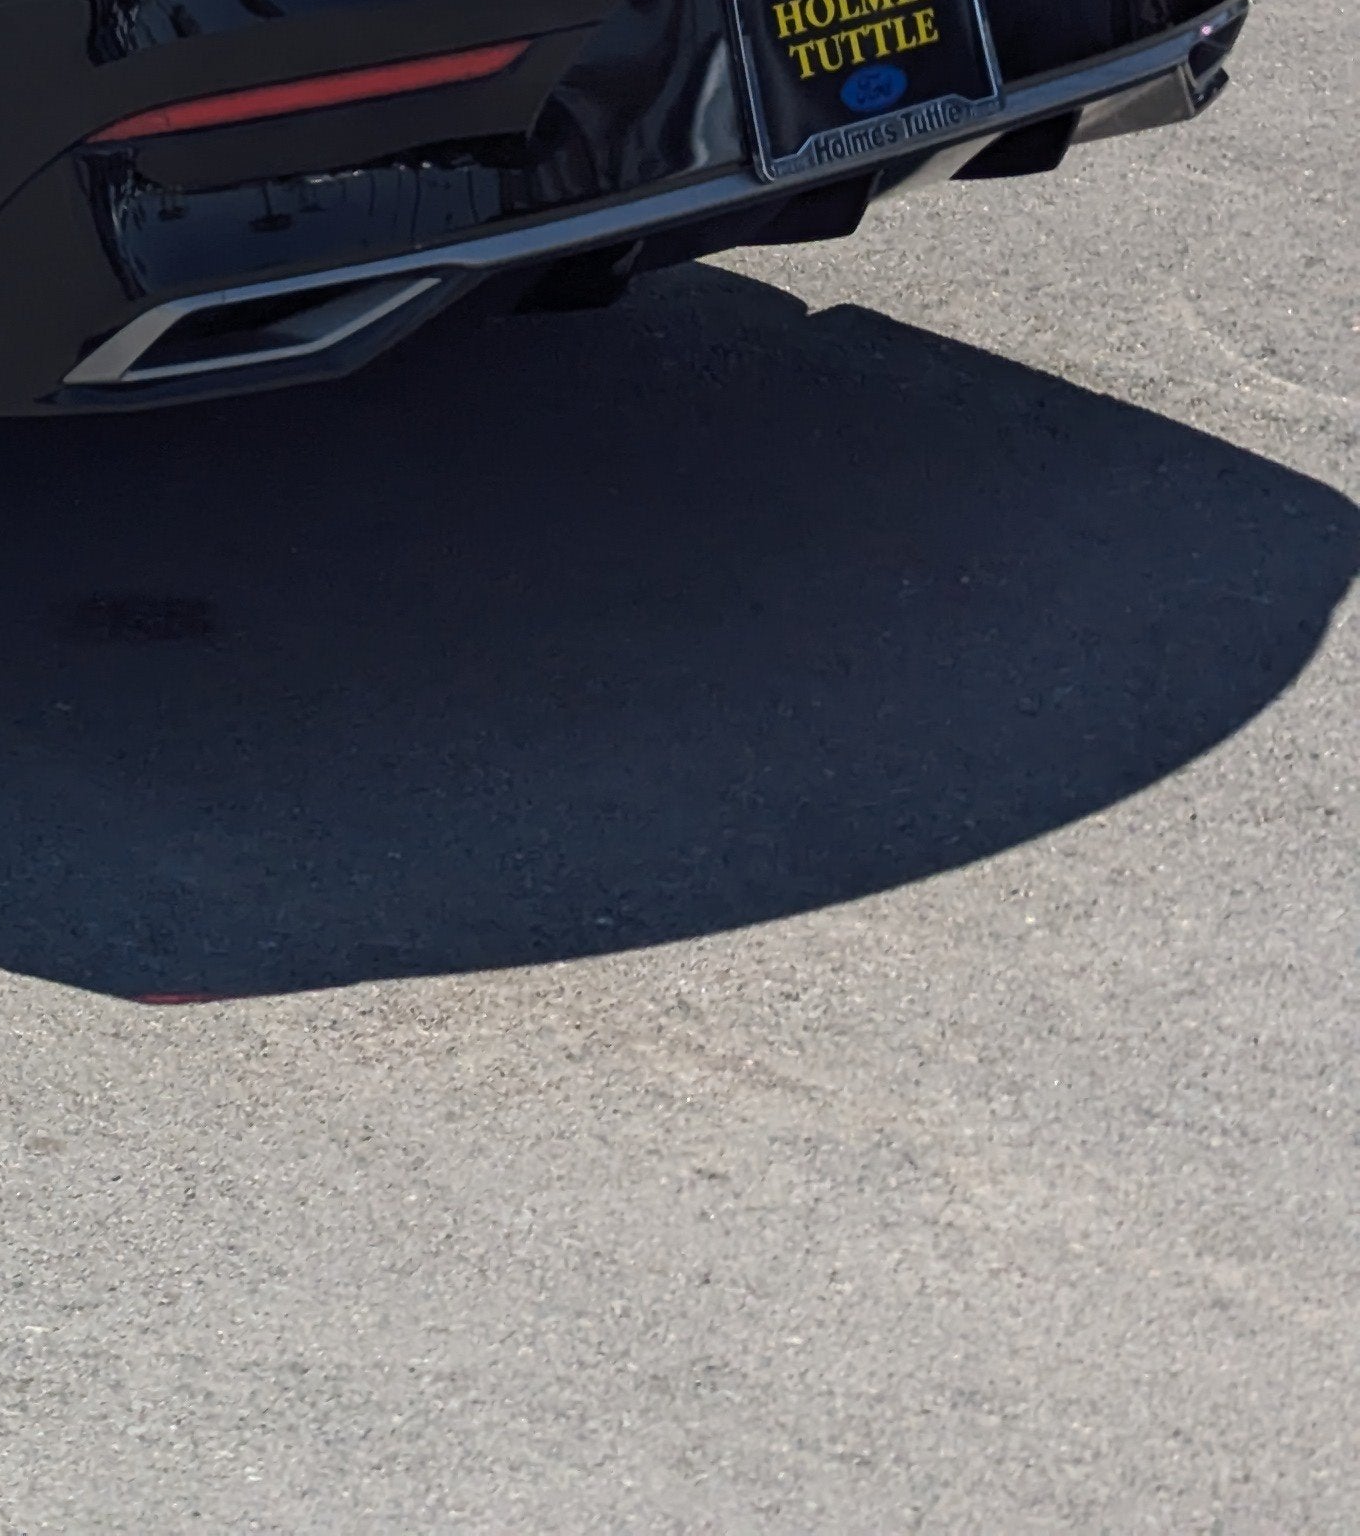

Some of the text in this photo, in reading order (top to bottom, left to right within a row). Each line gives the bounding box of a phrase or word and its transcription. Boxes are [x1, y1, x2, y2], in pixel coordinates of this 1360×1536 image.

[788, 7, 939, 80] TUTTLE
[811, 124, 898, 166] Holmes
[899, 101, 963, 140] Tuttle
